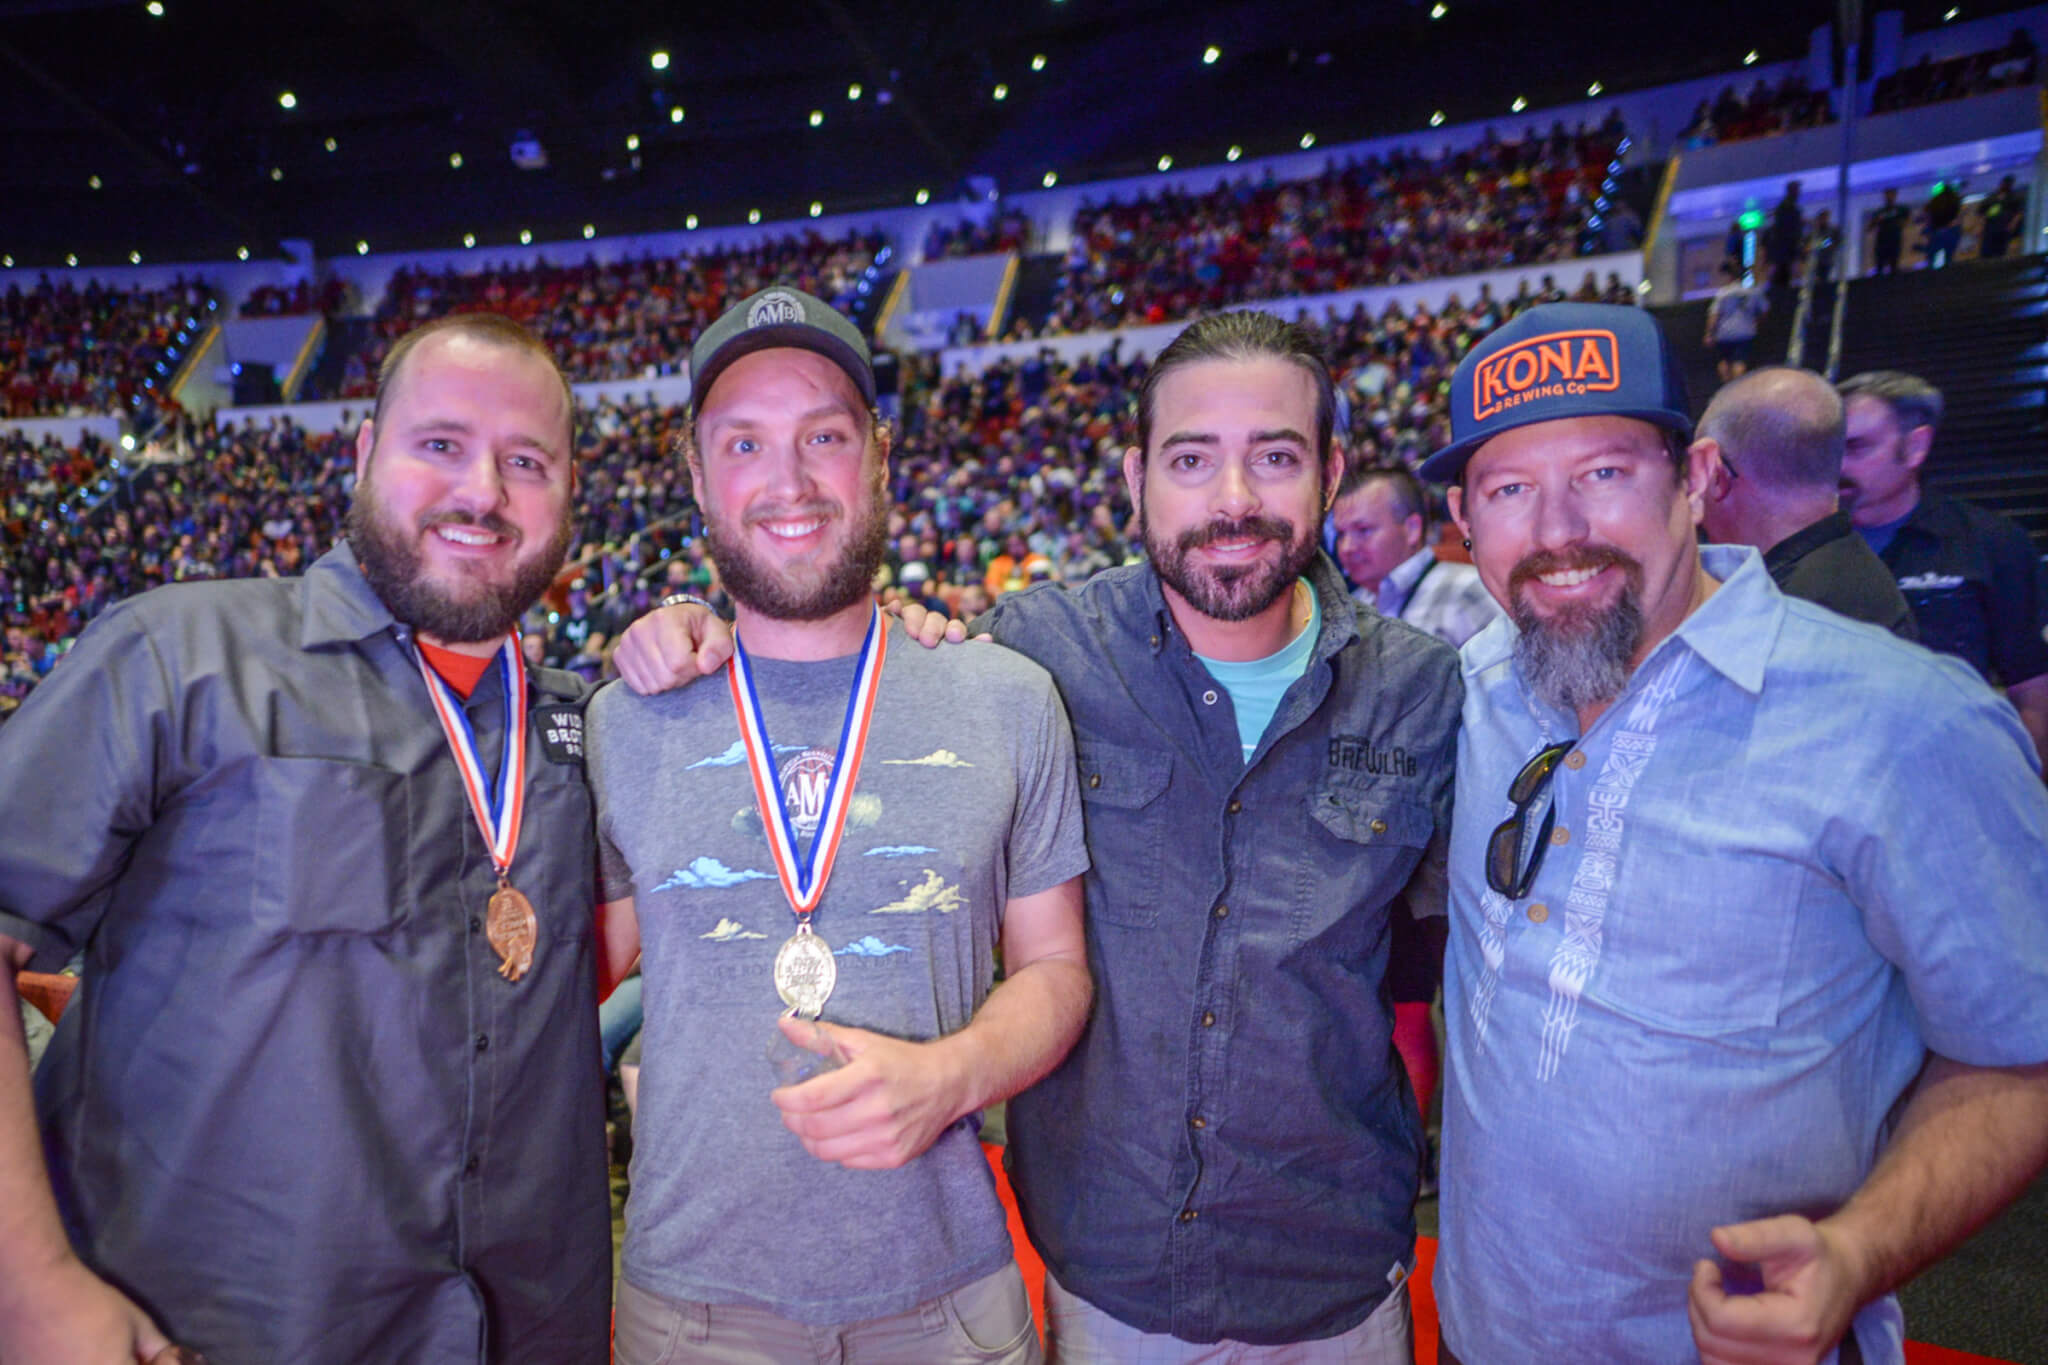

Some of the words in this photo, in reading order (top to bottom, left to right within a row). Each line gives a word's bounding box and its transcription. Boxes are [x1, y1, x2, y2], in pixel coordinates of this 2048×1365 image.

[758, 302, 794, 325] AMB
[1482, 339, 1610, 406] KONA
[1495, 383, 1564, 413] BREWING
[786, 771, 830, 820] AM
